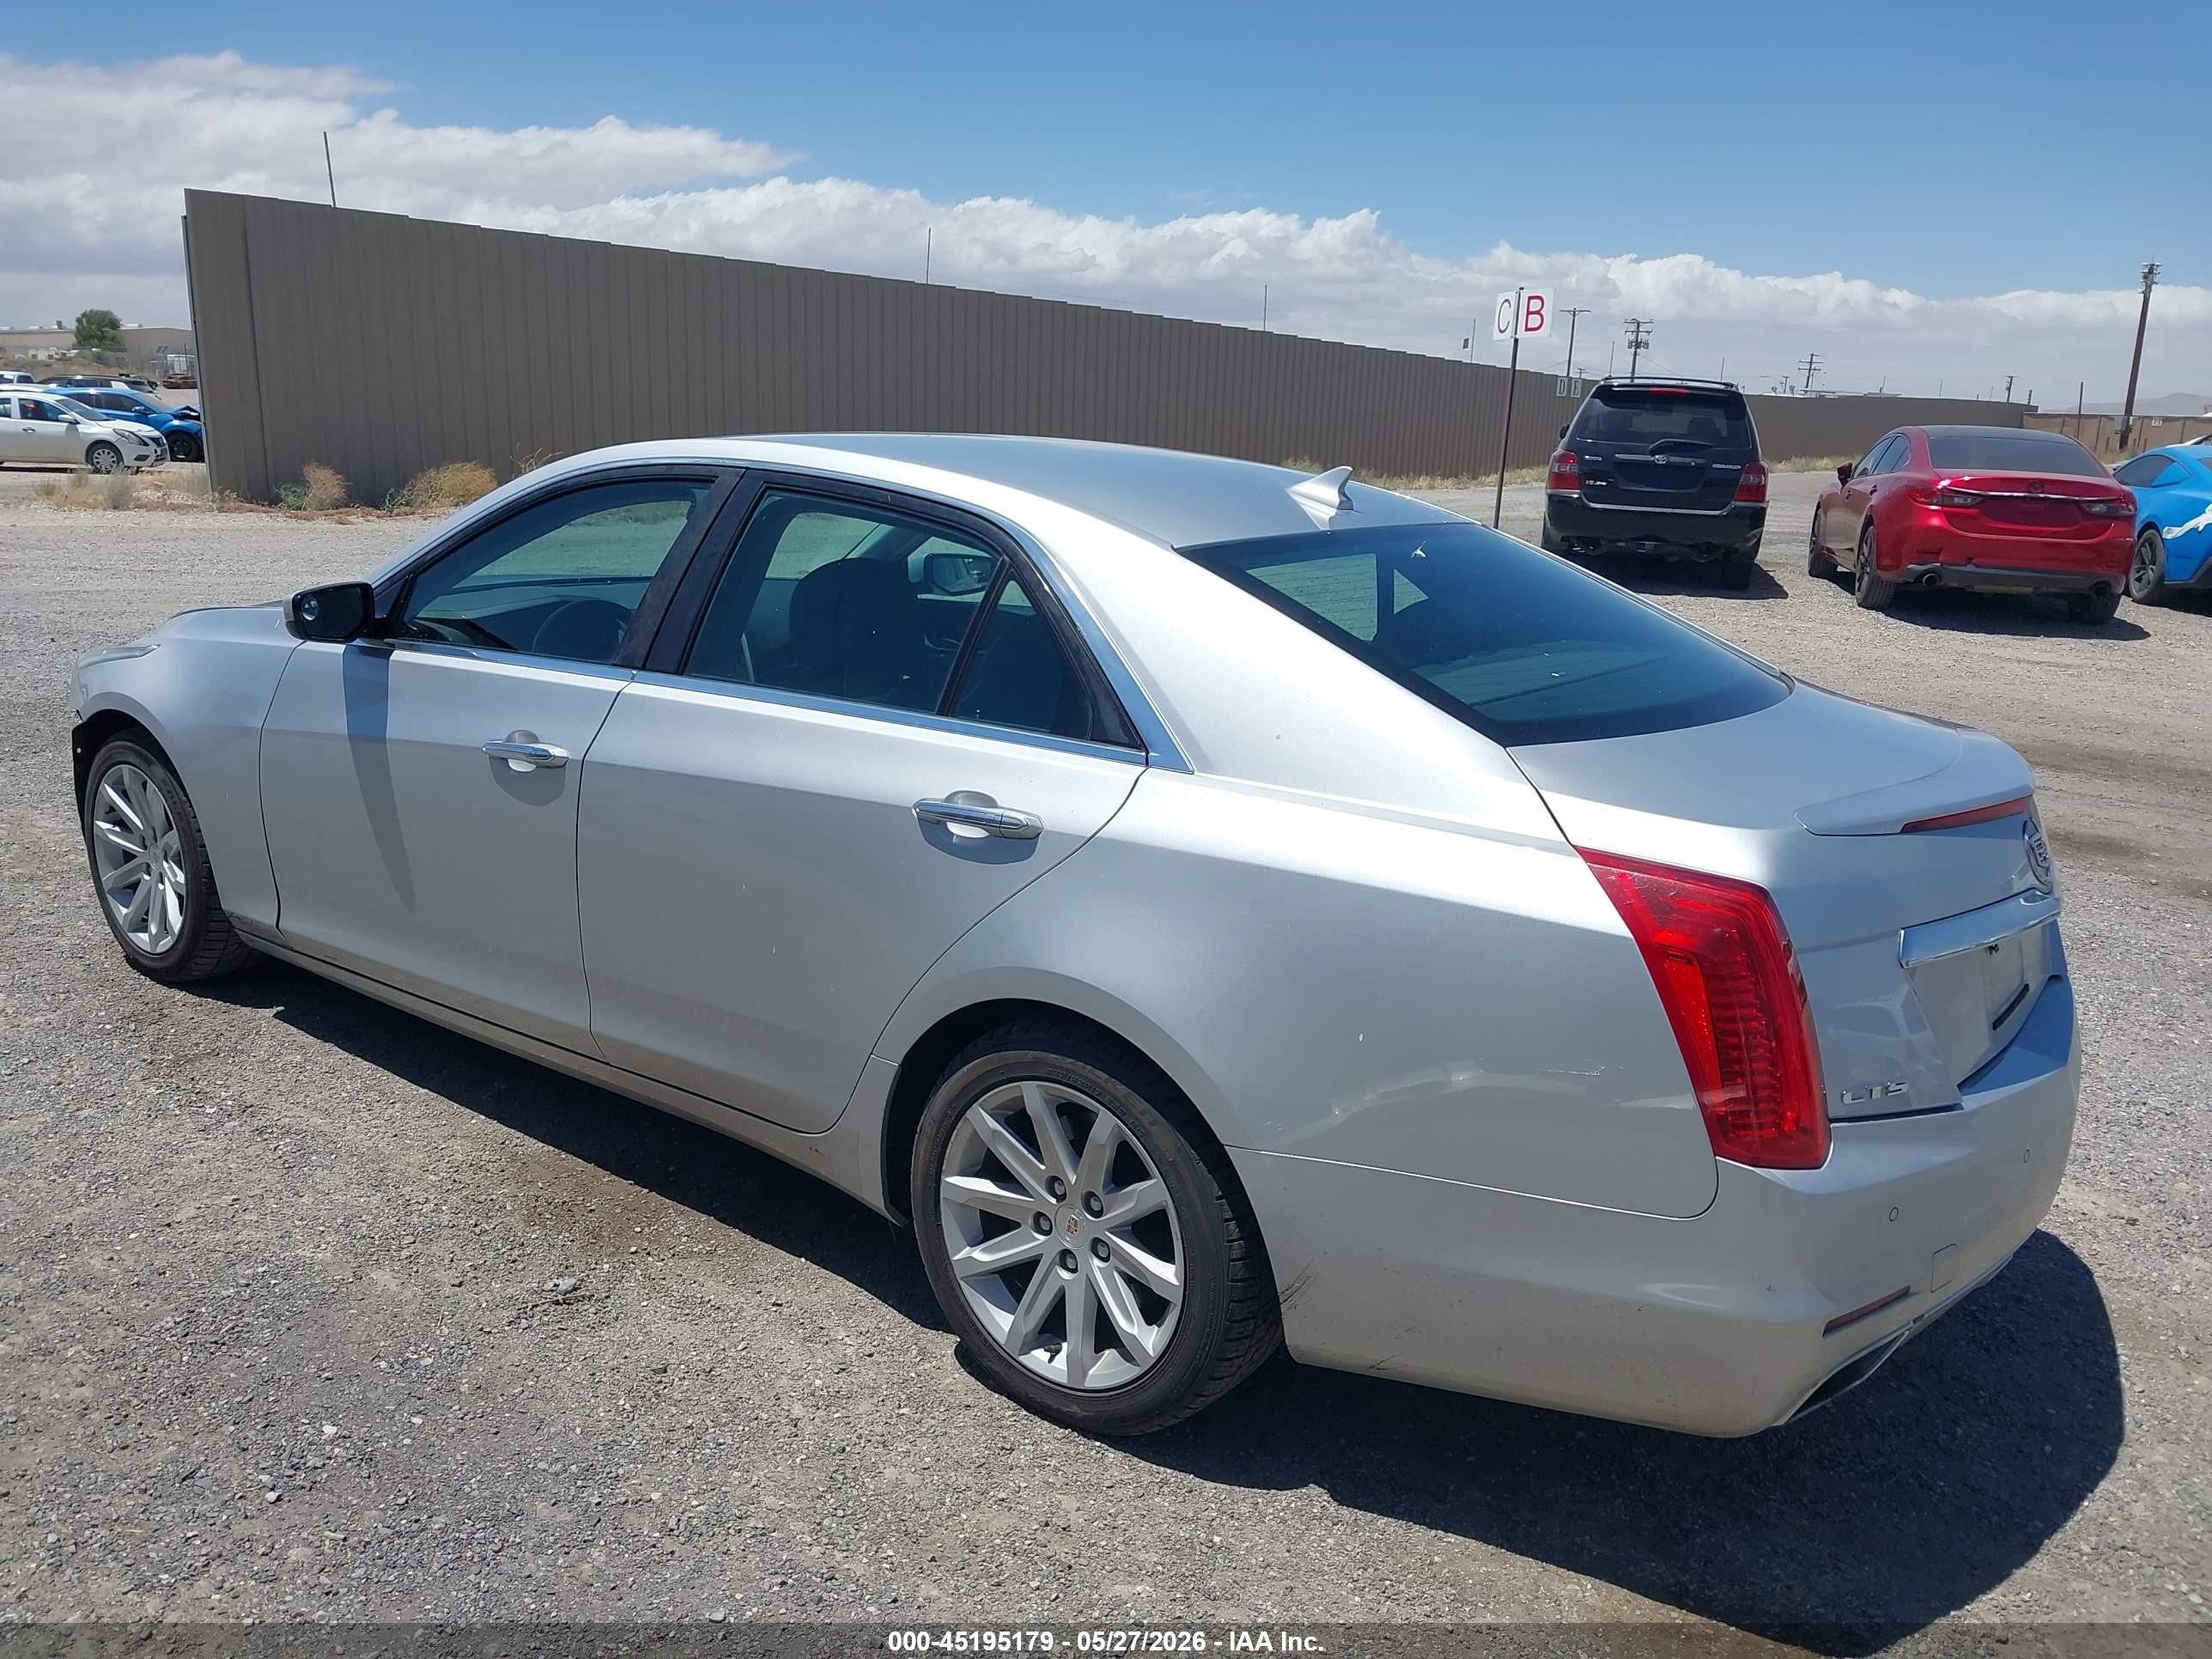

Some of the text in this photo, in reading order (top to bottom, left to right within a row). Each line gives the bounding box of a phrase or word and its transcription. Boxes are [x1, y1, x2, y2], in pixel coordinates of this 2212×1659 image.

[1498, 298, 1511, 334] C
[1524, 295, 1545, 332] B
[1559, 379, 1565, 395] D
[1573, 380, 1579, 396] E
[1842, 1081, 1909, 1105] CTS
